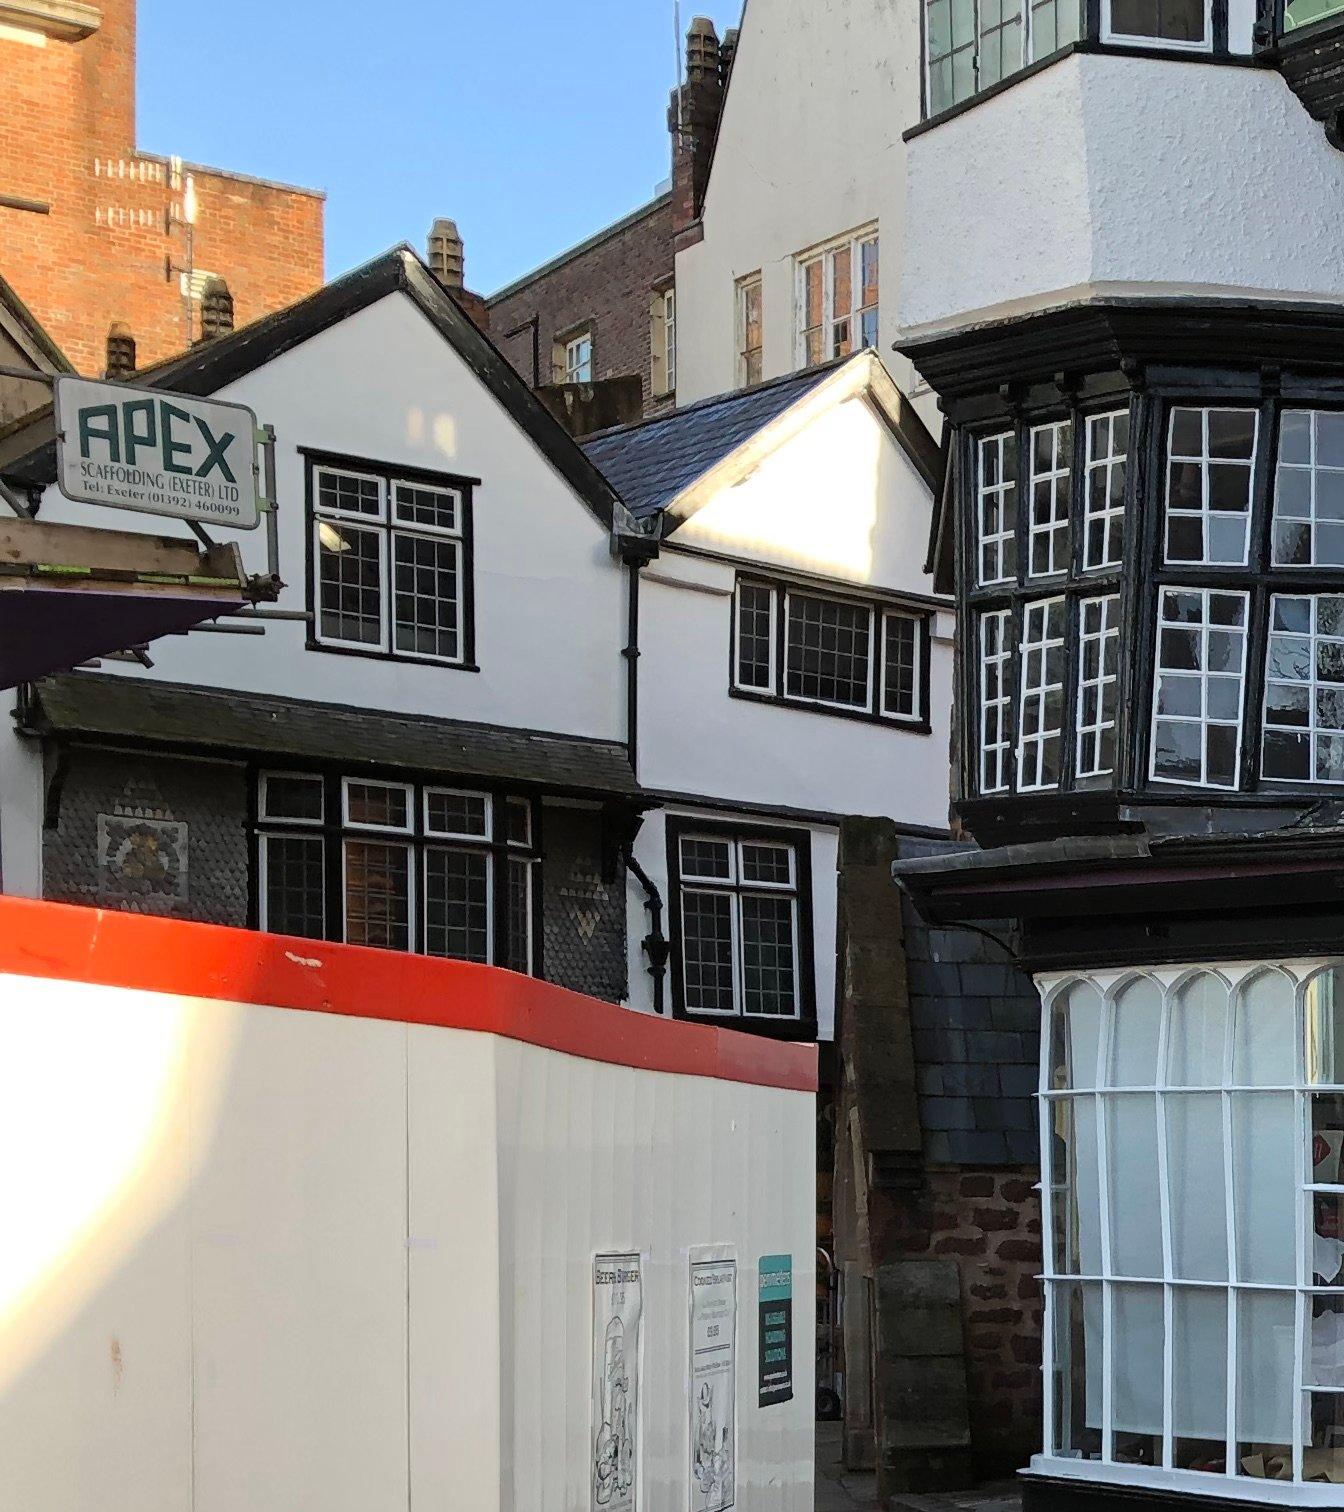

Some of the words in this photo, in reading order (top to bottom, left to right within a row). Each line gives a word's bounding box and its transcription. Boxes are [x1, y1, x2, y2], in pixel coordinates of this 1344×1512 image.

[78, 399, 237, 484] APEX
[80, 461, 165, 490] SCAFFOLDING
[168, 476, 215, 499] (EXETER)
[218, 485, 240, 502] LTD
[82, 480, 104, 494] Tel:
[107, 484, 146, 501] Exeter
